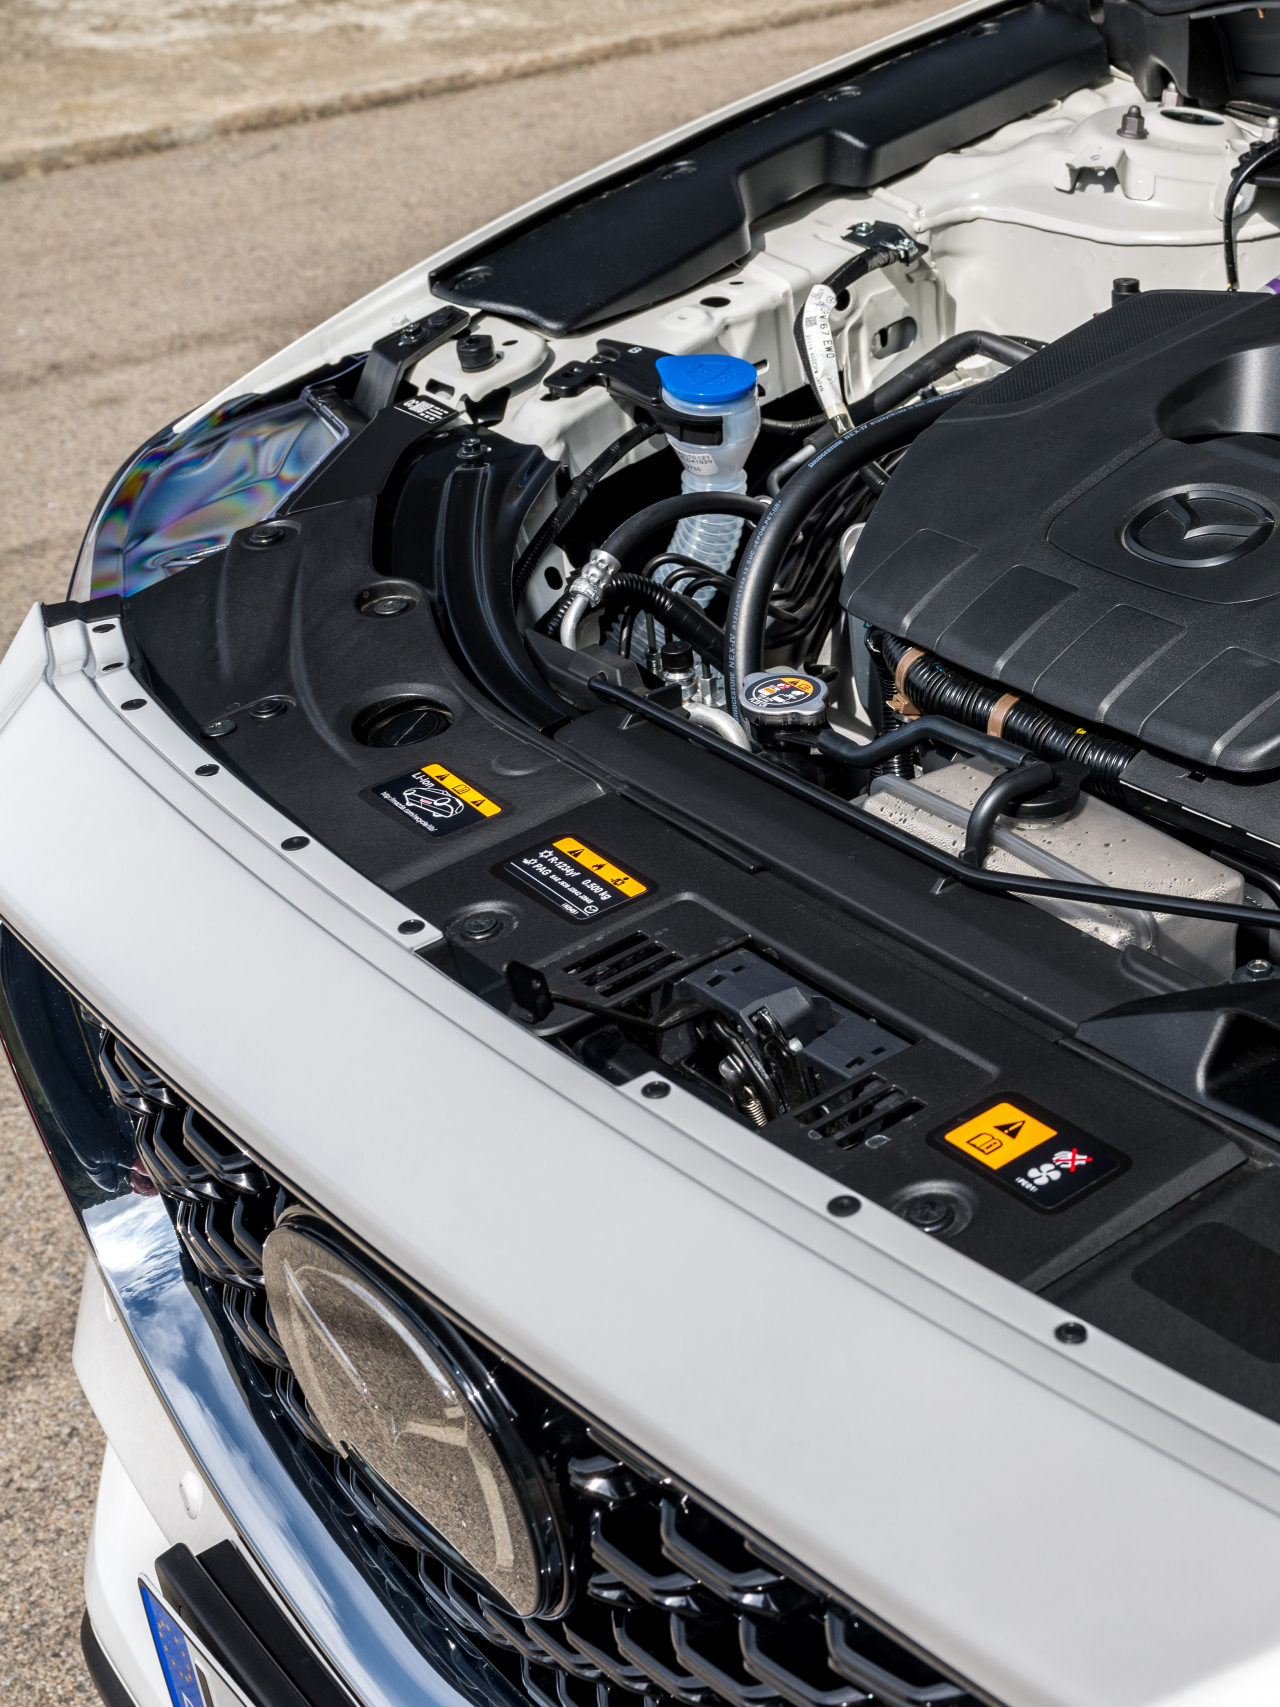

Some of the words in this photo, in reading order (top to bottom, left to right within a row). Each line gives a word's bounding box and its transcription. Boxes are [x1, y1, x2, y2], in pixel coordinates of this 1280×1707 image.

[728, 633, 737, 669] NEX-IV
[747, 550, 755, 565] SUC
[411, 771, 435, 788] Li-ion
[531, 861, 550, 876] PAG
[546, 855, 581, 879] R-1234yf
[598, 889, 612, 901] kg
